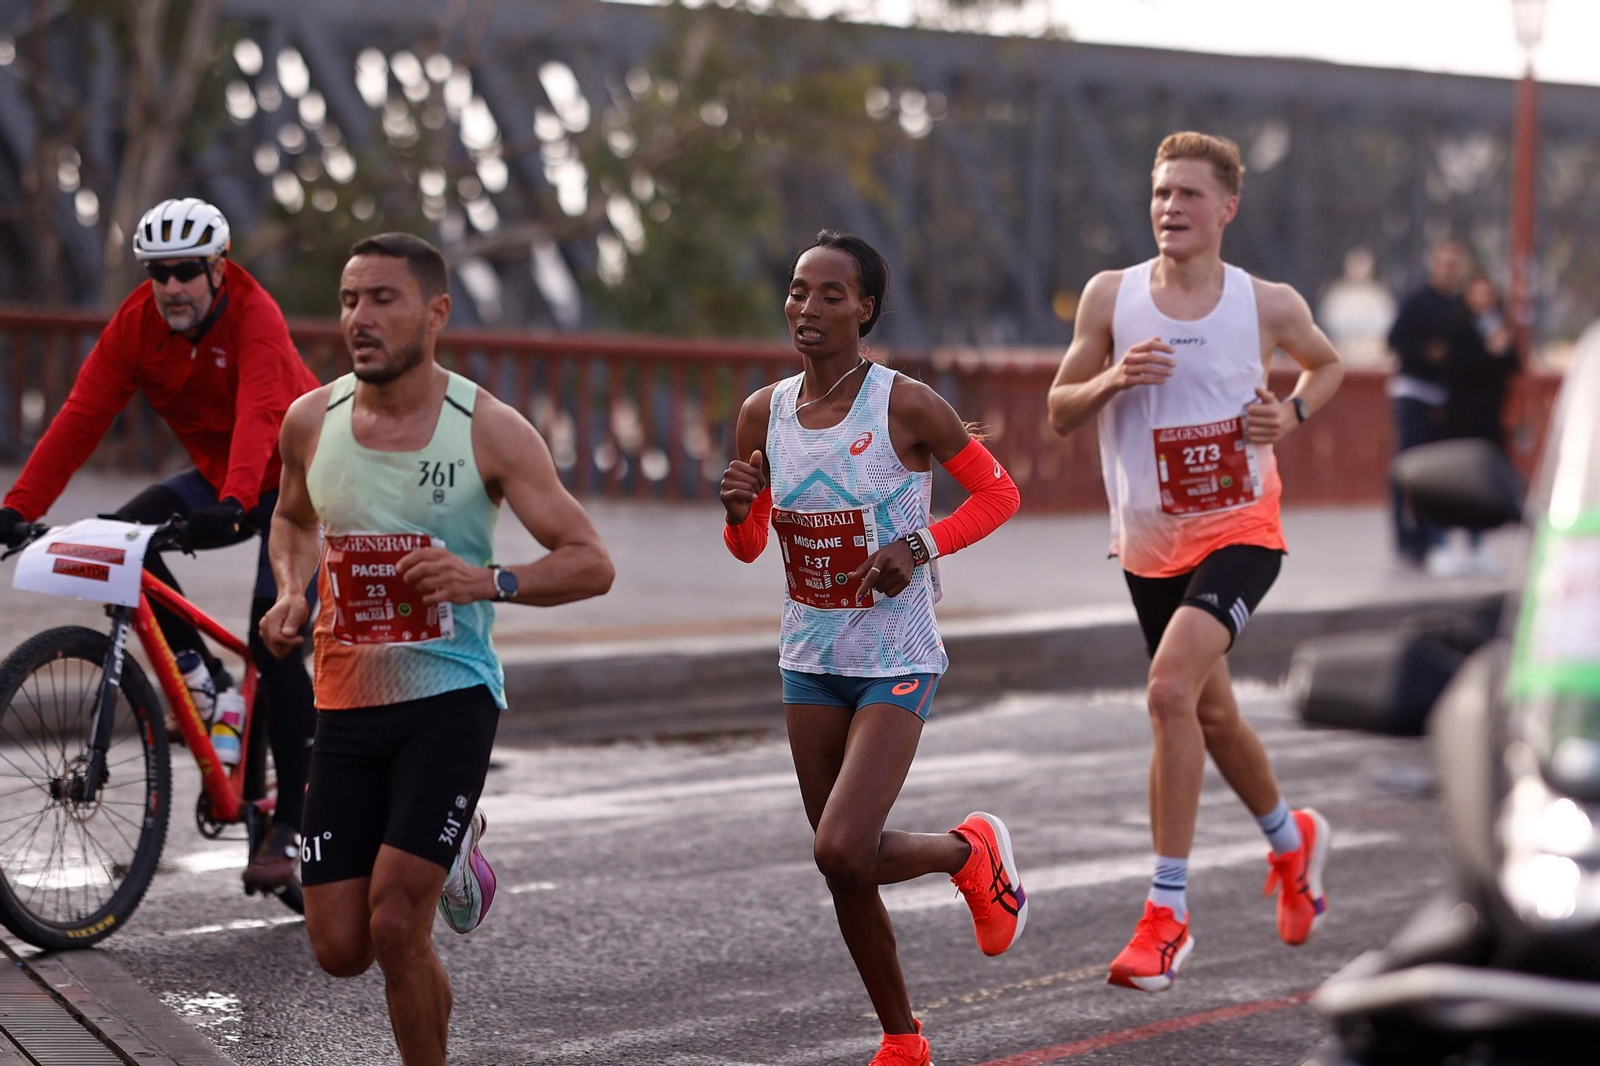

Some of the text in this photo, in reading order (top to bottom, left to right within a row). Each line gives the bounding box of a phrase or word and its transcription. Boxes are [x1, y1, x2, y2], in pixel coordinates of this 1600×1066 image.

[1170, 337, 1199, 346] CRAFT
[1176, 419, 1238, 441] GENERALI
[1182, 443, 1221, 466] 273
[791, 511, 856, 529] GENERALI
[345, 536, 421, 552] GENERALI
[793, 534, 843, 550] MISGANE
[866, 529, 875, 543] BOX
[351, 563, 397, 577] PACER
[804, 555, 831, 569] F-37
[365, 584, 387, 598] 23
[301, 830, 333, 863] 61°
